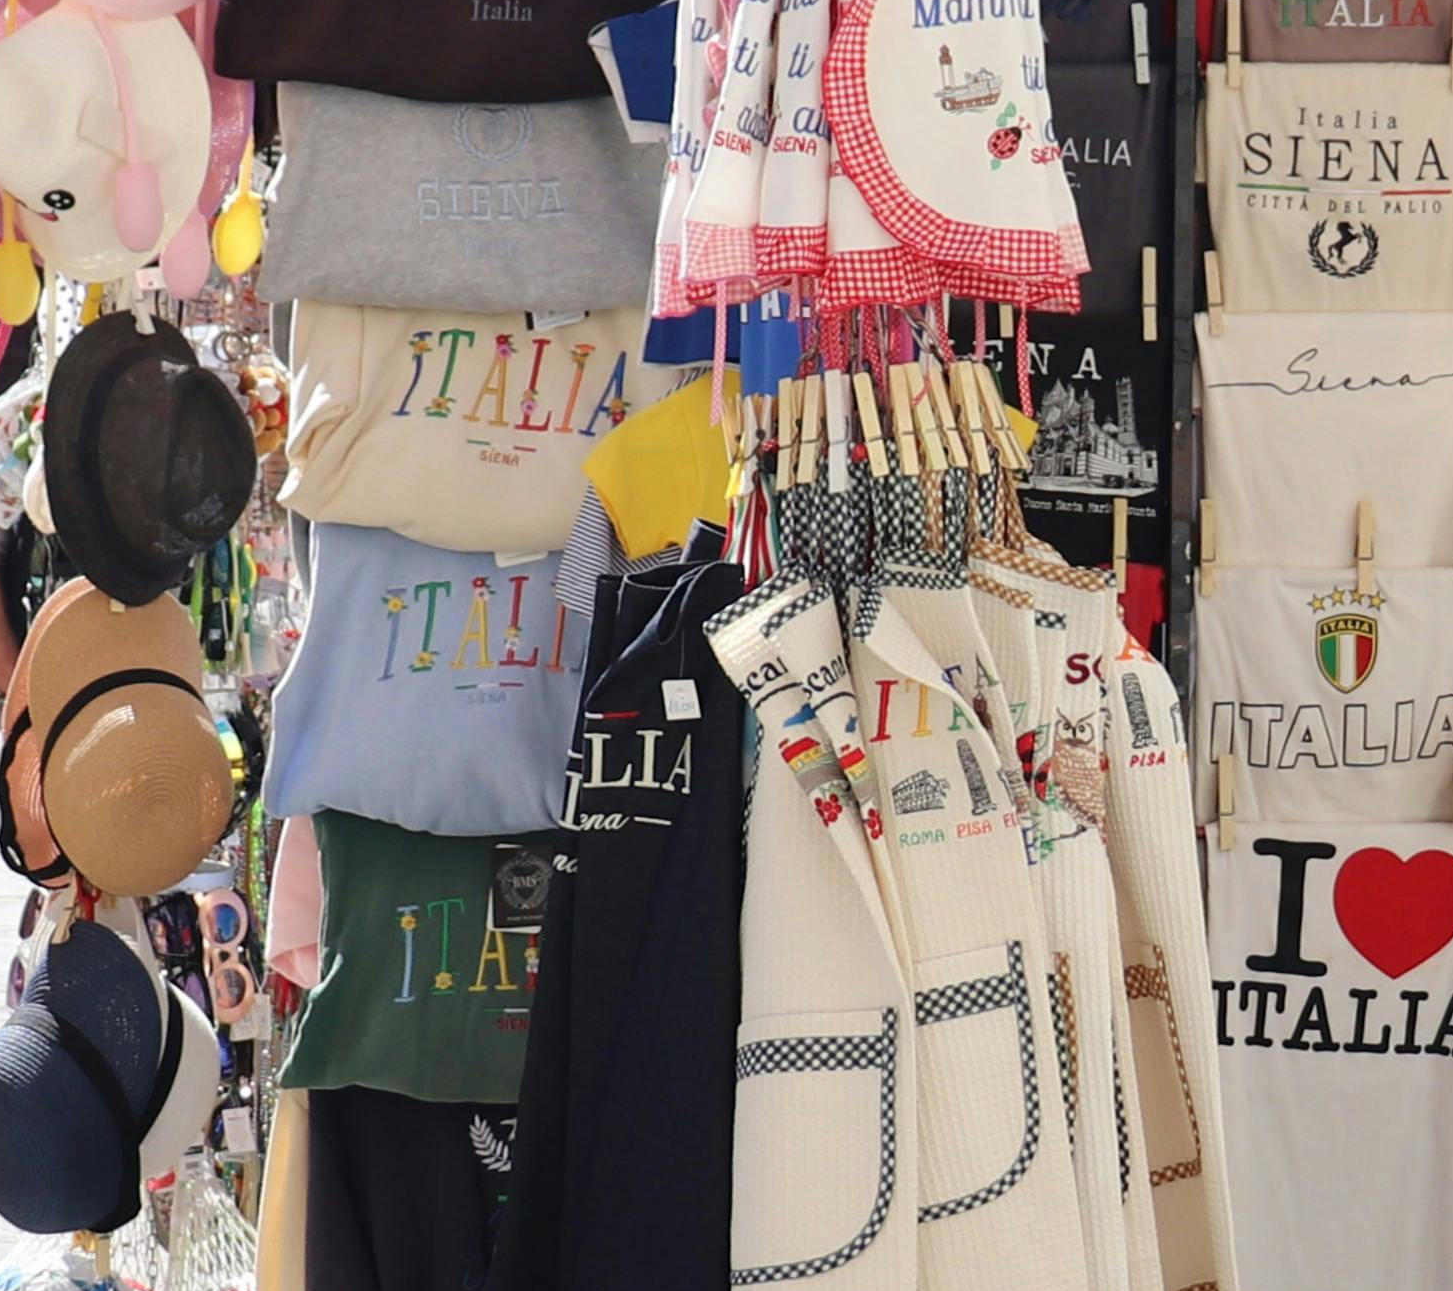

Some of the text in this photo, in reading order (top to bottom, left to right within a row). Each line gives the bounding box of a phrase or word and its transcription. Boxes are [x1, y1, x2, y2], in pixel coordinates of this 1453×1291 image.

[1298, 106, 1400, 130] Italia
[772, 135, 817, 157] SIENA
[1242, 131, 1450, 183] SIENA
[415, 176, 570, 224] SIENA
[1327, 199, 1367, 215] DEL
[1383, 199, 1443, 215] PALIO
[391, 328, 632, 439] ITALIA
[1321, 617, 1372, 635] ITALIA
[1129, 750, 1167, 768] PISA
[898, 829, 946, 849] ROMA
[956, 819, 994, 839] PISA
[1245, 836, 1337, 978] I
